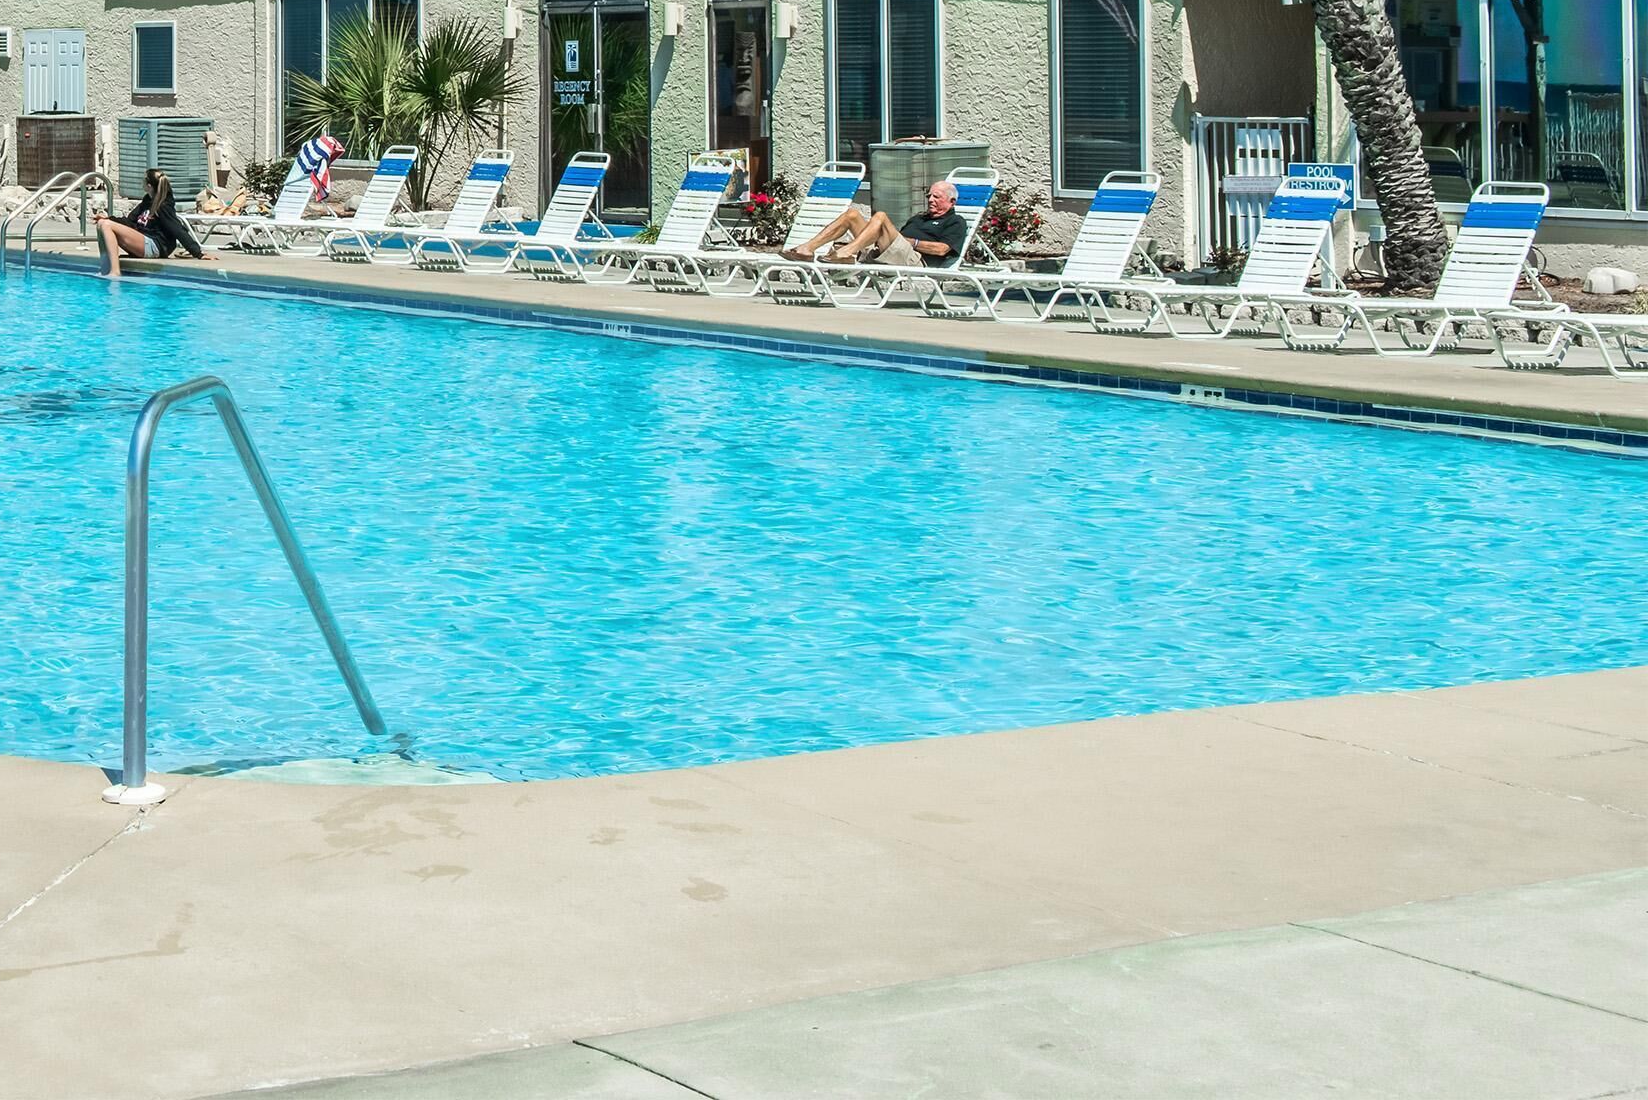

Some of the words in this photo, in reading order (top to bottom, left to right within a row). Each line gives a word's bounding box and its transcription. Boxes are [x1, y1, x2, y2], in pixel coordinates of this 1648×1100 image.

[553, 80, 591, 92] REGENCY
[560, 93, 585, 105] ROOM
[1306, 166, 1336, 177] POOL
[1291, 180, 1352, 191] RESTROOM
